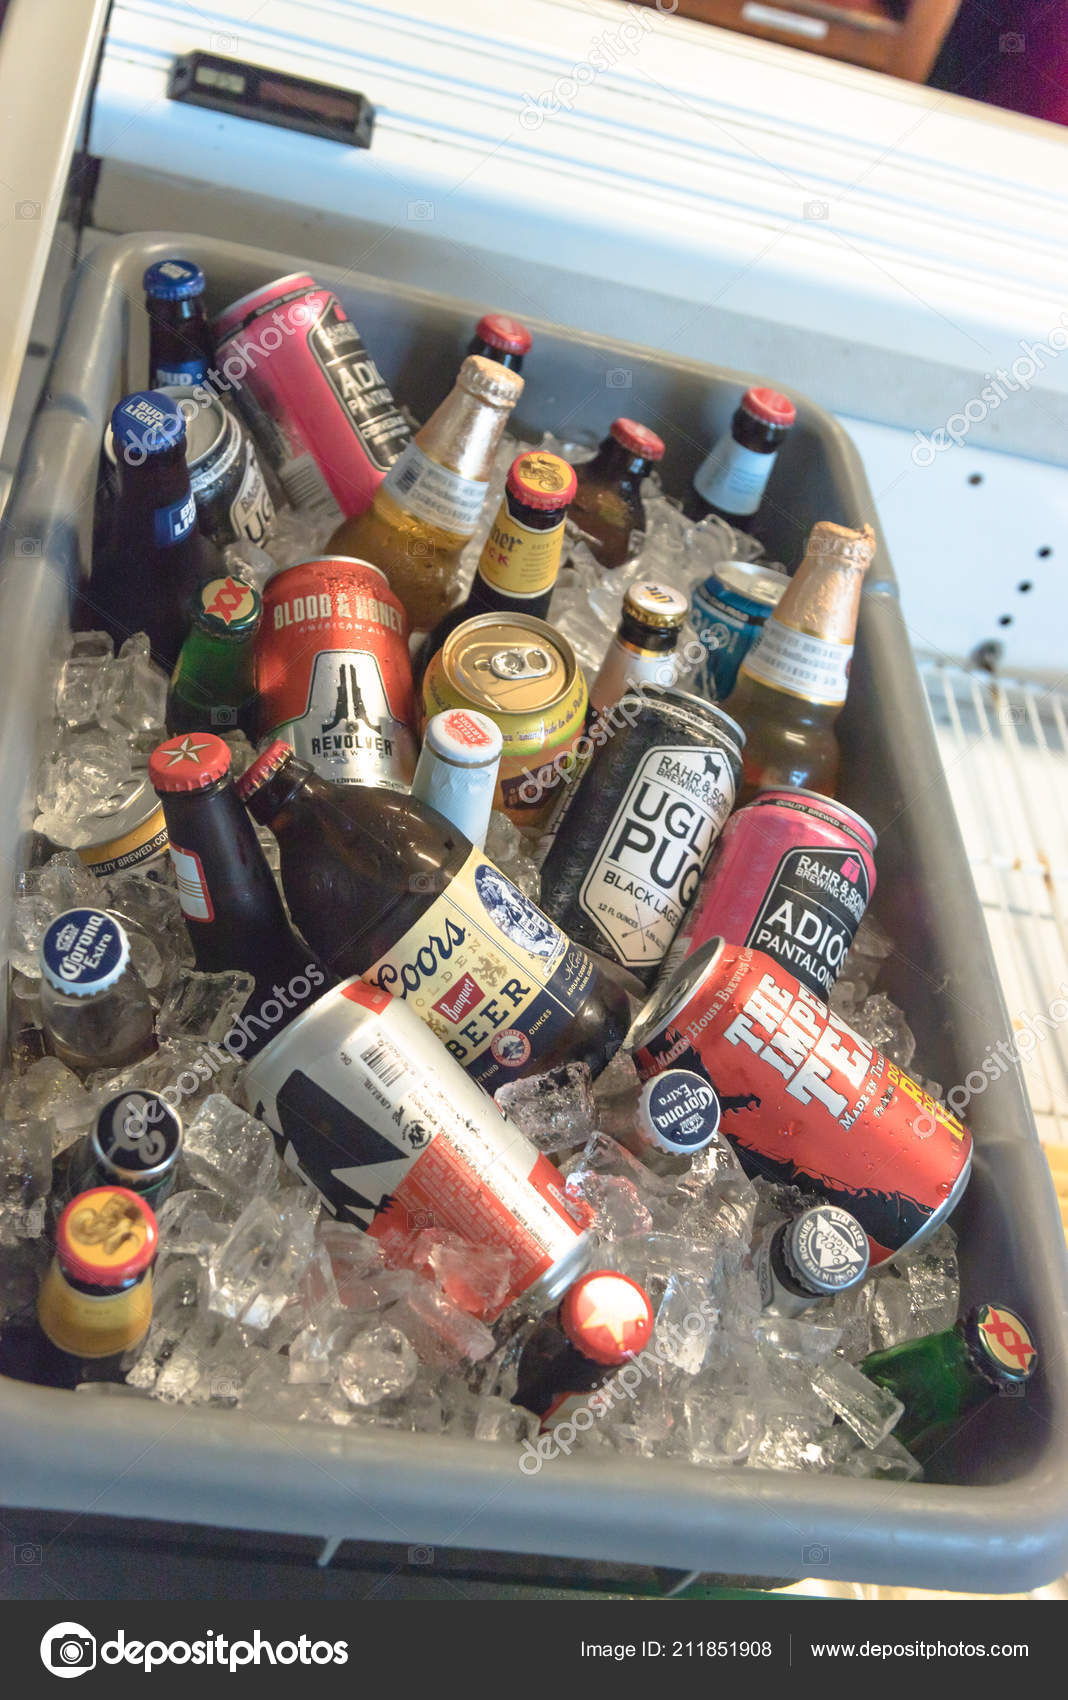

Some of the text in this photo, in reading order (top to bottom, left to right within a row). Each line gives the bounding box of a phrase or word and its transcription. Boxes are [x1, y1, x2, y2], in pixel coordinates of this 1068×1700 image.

[125, 404, 163, 429] LIGHT
[137, 401, 165, 420] BUD
[274, 593, 402, 635] BLOOD & HONEY
[299, 621, 364, 633] AMERICAN
[311, 735, 393, 756] REVOLVER
[657, 767, 702, 800] BREWING
[660, 755, 702, 787] RAHR
[702, 778, 712, 792] &
[808, 808, 840, 826] BREWED
[118, 845, 153, 868] BREWED
[797, 855, 840, 887] RAHR
[840, 880, 850, 893] &
[603, 870, 655, 907] BLACK
[795, 866, 840, 898] BREWING
[615, 911, 639, 929] OUNCES
[59, 913, 105, 981] Corona
[84, 933, 113, 970] Extra
[370, 917, 467, 999] Coors
[440, 977, 476, 1022] Banquet
[723, 972, 794, 1053] THE
[447, 978, 531, 1060] BEER
[528, 1008, 552, 1036] OUNCES
[690, 1000, 723, 1038] HOUSE
[656, 1086, 713, 1129] Corona
[658, 1082, 690, 1106] Extra
[838, 1092, 870, 1132] MADE
[798, 1219, 814, 1261] ROCKIES
[816, 1231, 850, 1266] Coors
[827, 1230, 850, 1254] LIGHT
[804, 1262, 821, 1278] THE
